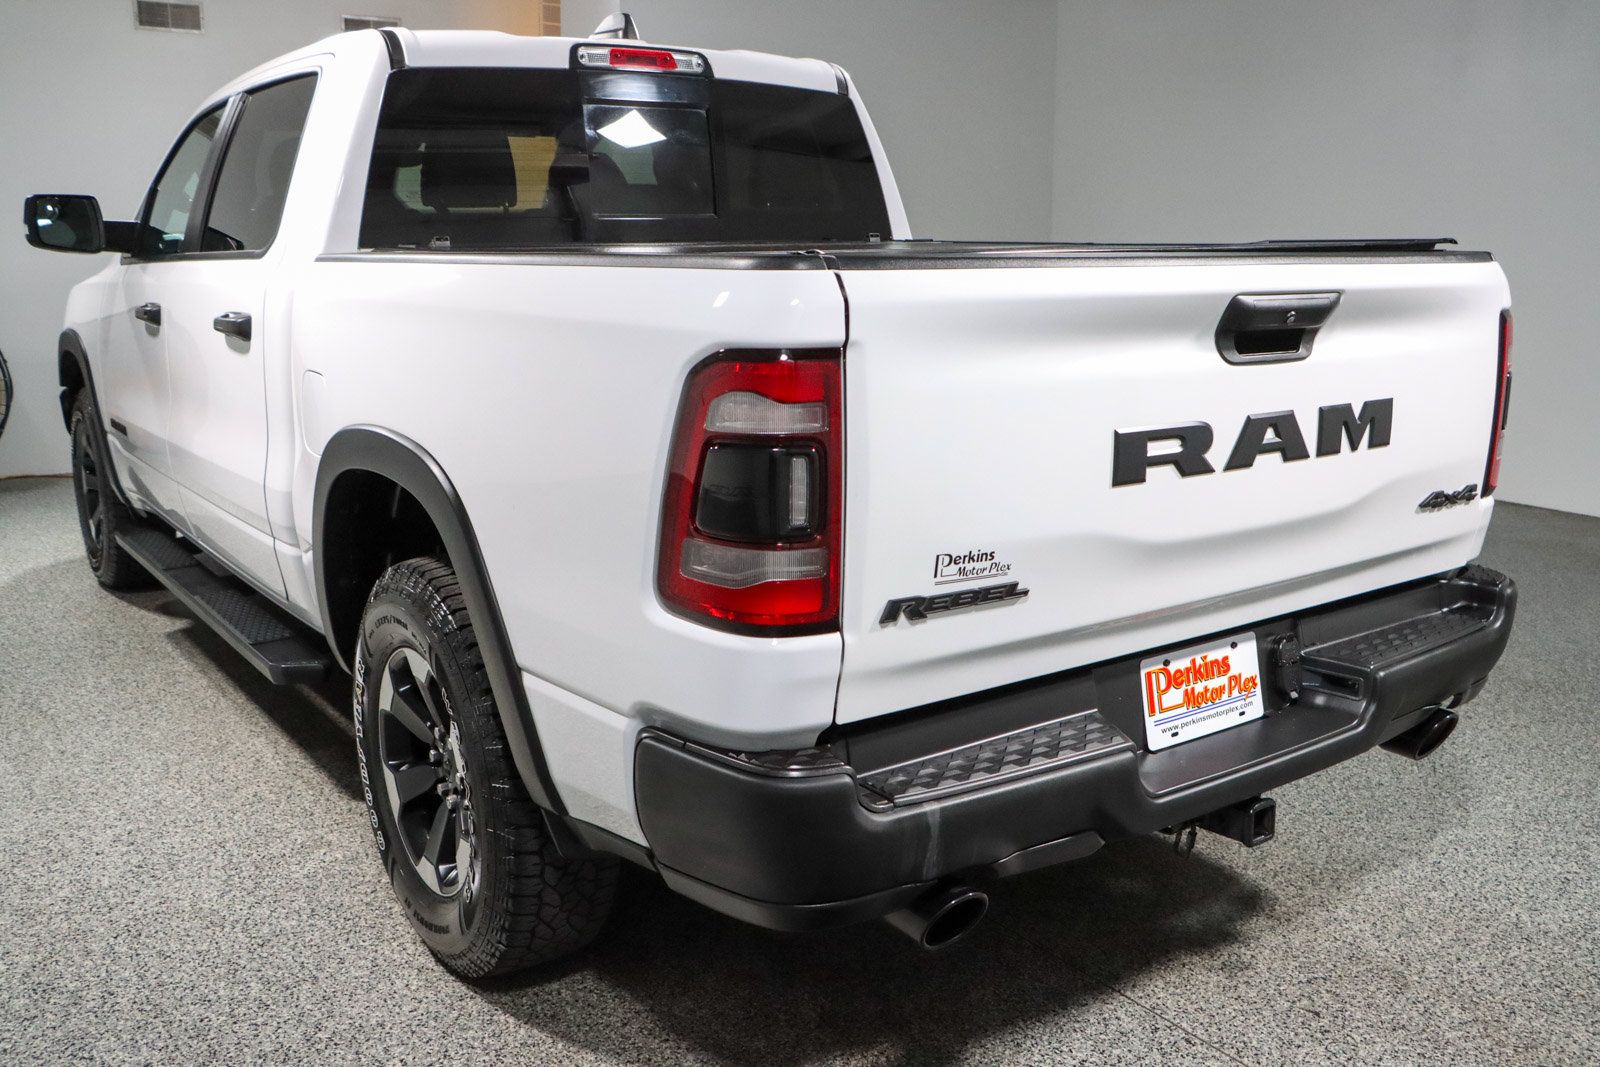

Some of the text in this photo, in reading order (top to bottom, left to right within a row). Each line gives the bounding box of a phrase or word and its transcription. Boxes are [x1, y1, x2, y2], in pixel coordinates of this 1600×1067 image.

[1111, 398, 1394, 487] RAM
[934, 550, 995, 578] Perkins
[956, 562, 1012, 578] Motor Plex
[879, 581, 1030, 624] REBEL
[1145, 654, 1231, 717] Perkins
[1183, 672, 1258, 710] Motor Plex
[1160, 701, 1254, 734] www.perkinsmotorplex.com
